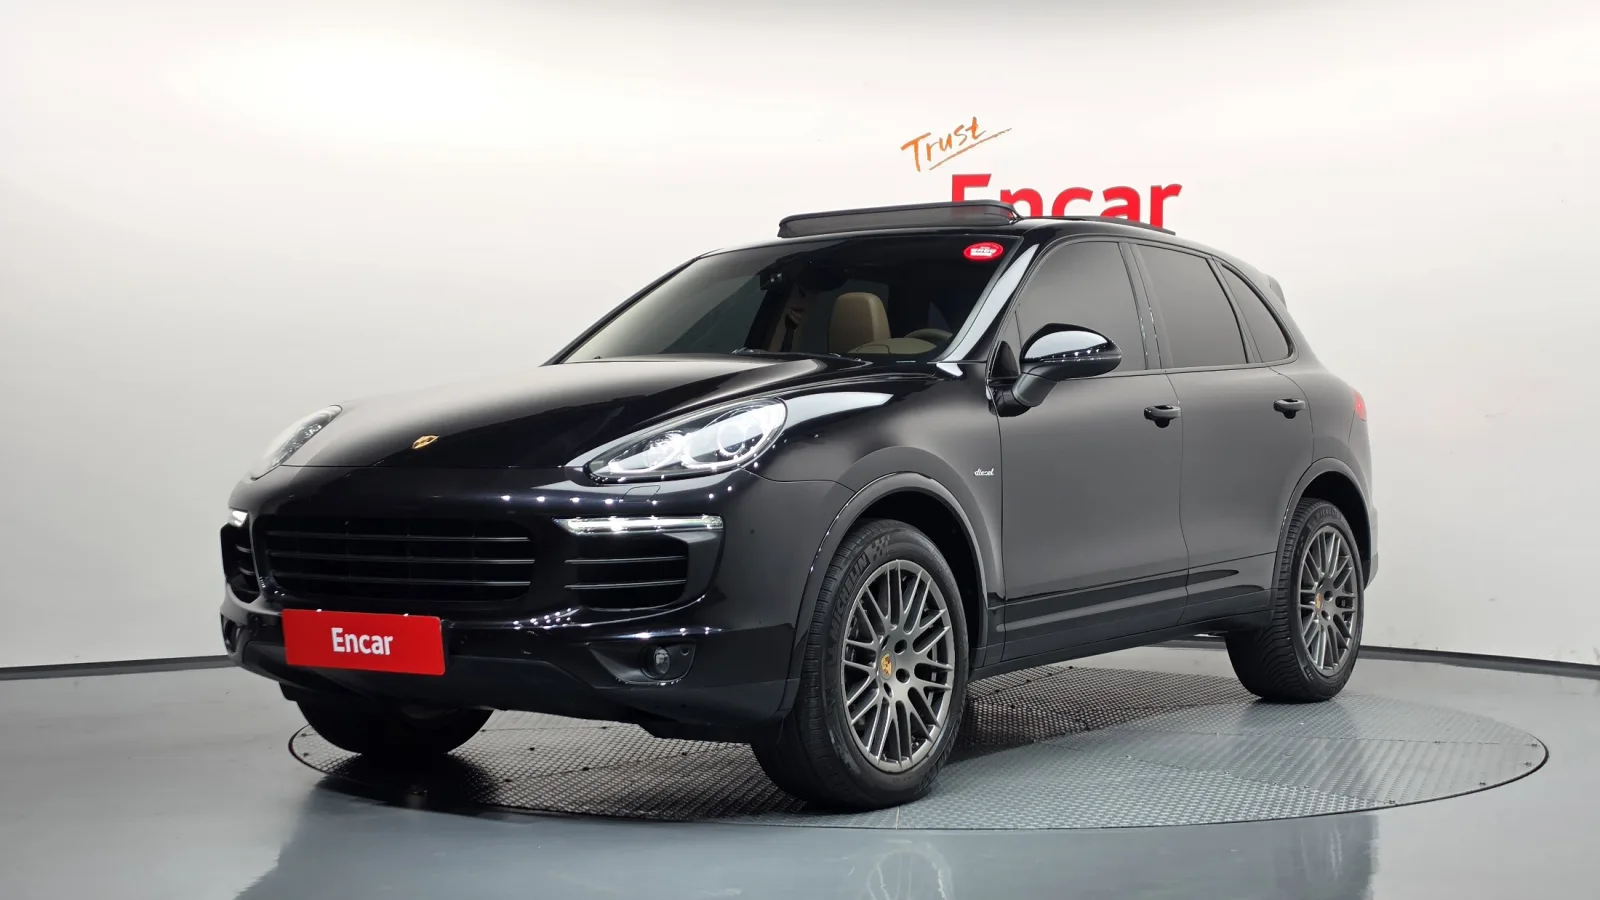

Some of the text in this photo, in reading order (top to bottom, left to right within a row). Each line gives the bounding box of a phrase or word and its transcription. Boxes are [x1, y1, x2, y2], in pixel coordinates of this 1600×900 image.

[900, 116, 987, 172] Trust
[974, 467, 995, 477] diesel
[829, 551, 870, 644] MICHELIN
[331, 627, 394, 656] Encar
